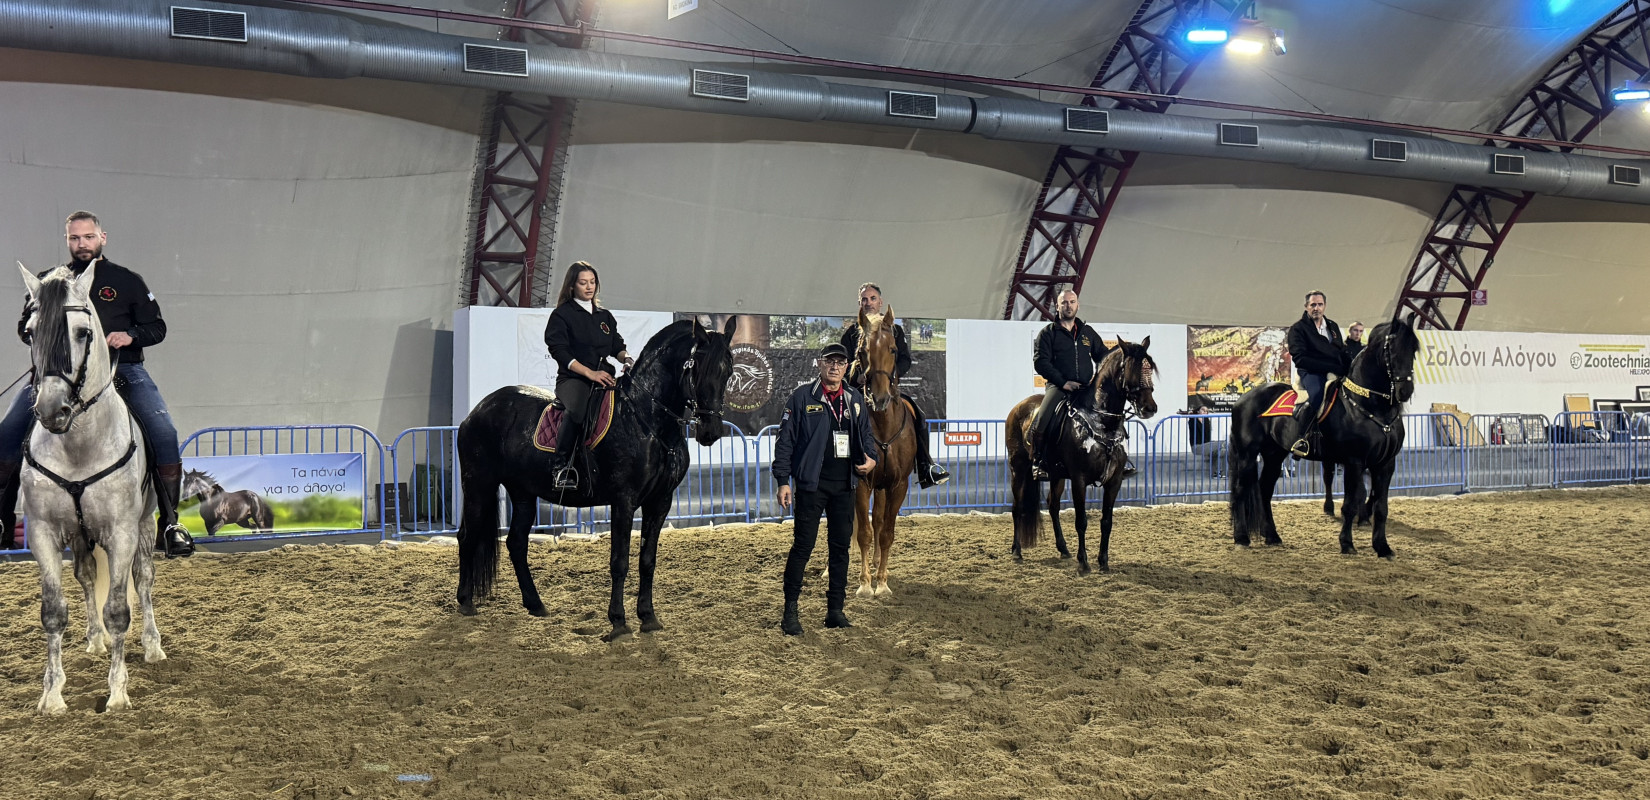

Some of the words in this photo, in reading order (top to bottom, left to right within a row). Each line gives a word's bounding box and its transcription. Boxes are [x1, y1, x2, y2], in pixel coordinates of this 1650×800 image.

[1426, 344, 1486, 367] Σαλόνι
[1491, 345, 1557, 372] Αλόγου
[1584, 354, 1650, 368] Zootechnia
[291, 467, 307, 478] Τα
[311, 467, 346, 478] πάντα
[264, 486, 283, 496] για
[287, 485, 299, 494] το
[303, 482, 346, 494] άλογο!
